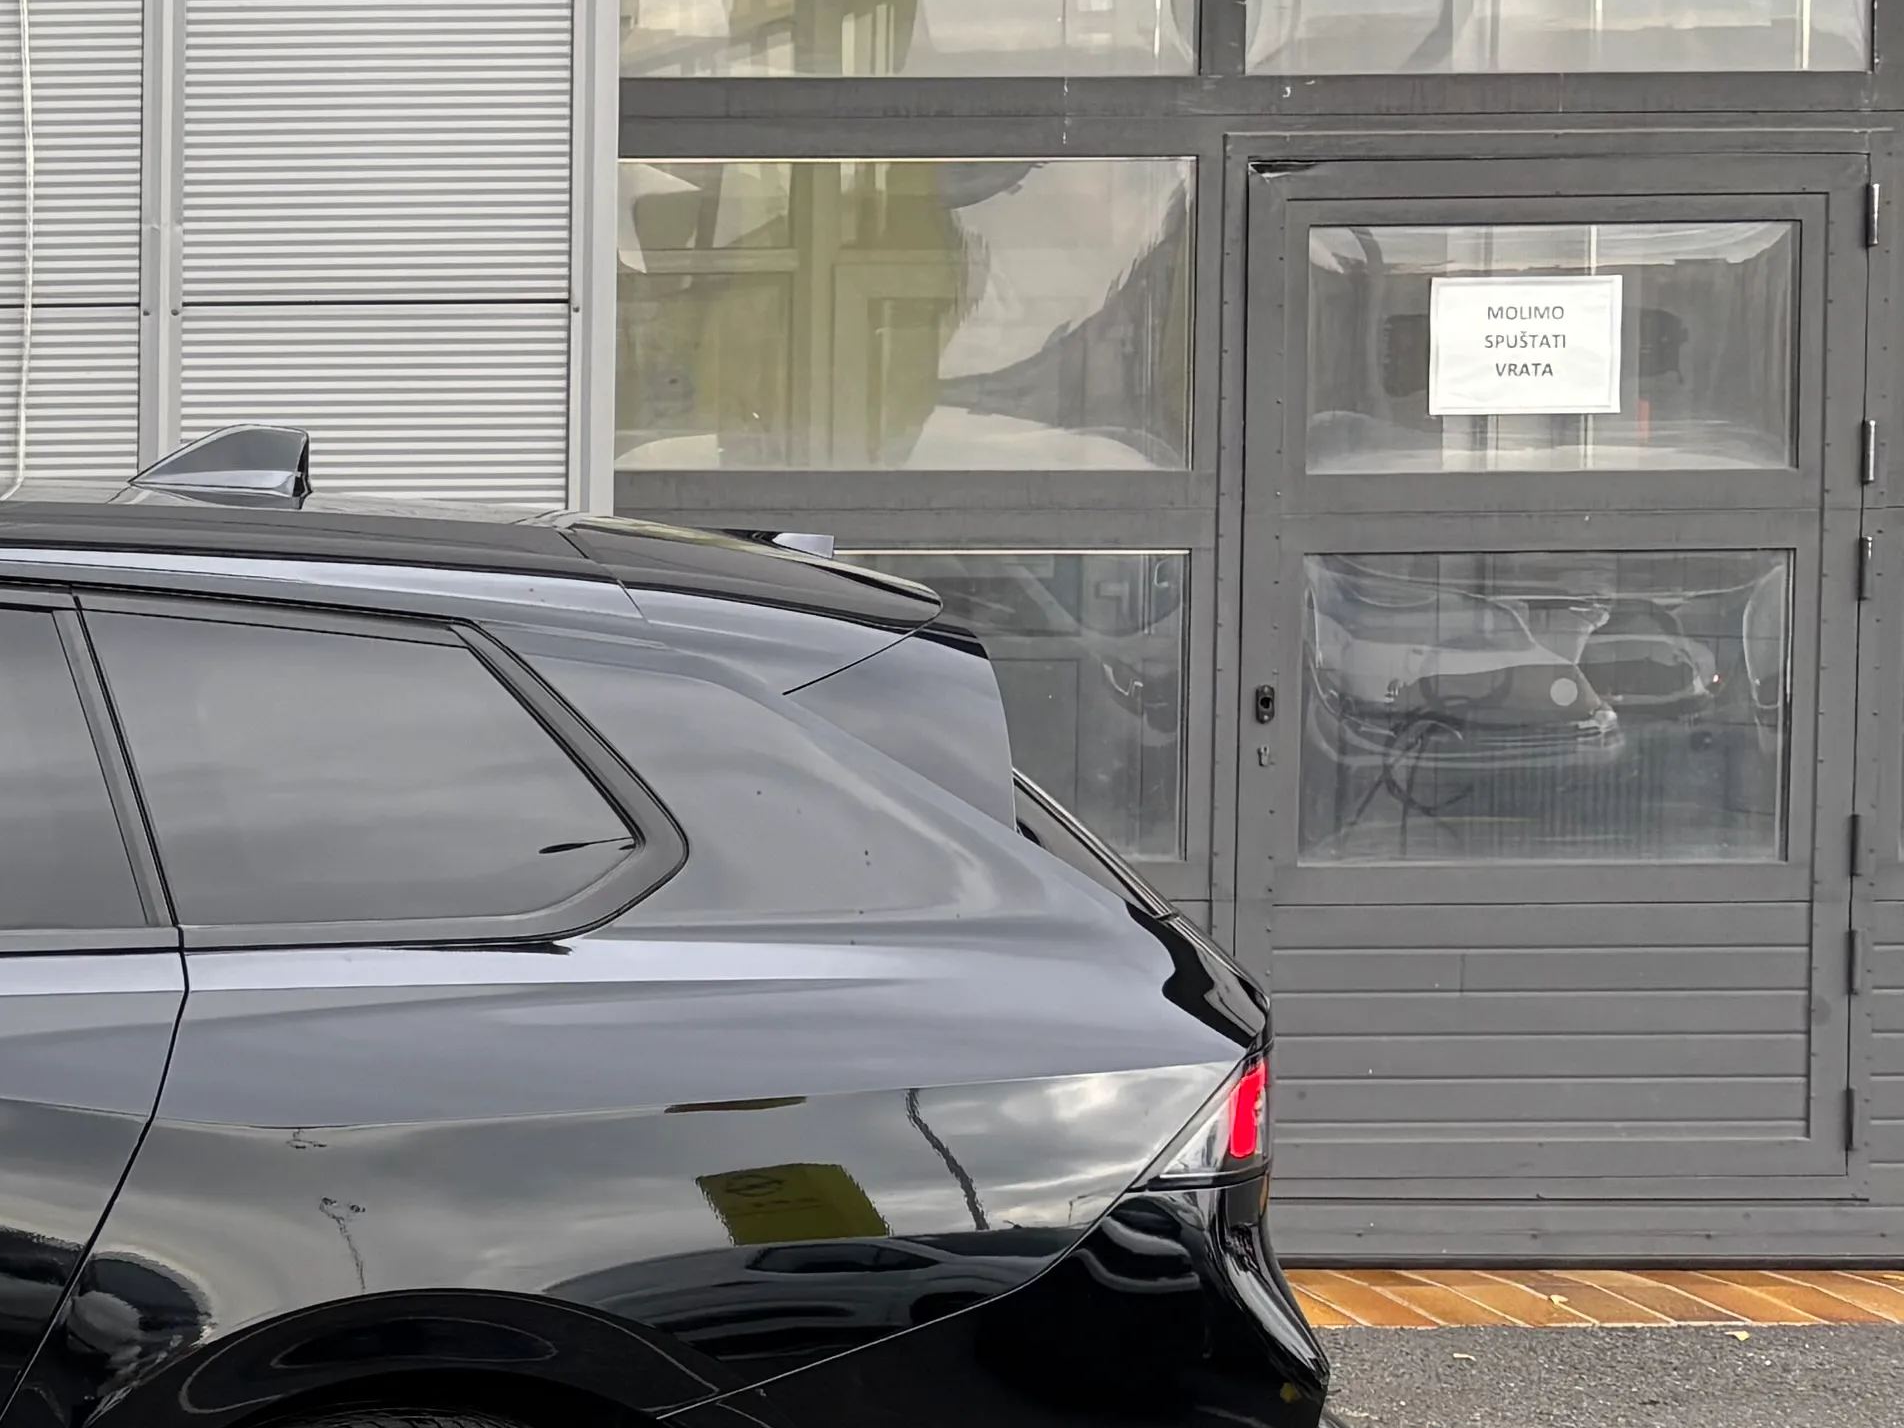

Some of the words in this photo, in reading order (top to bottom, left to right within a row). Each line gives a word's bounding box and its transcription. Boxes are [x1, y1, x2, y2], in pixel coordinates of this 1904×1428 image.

[1487, 305, 1565, 320] MOLIMO
[1484, 330, 1567, 349] SPUŠTATI
[1495, 362, 1554, 377] VRATA
